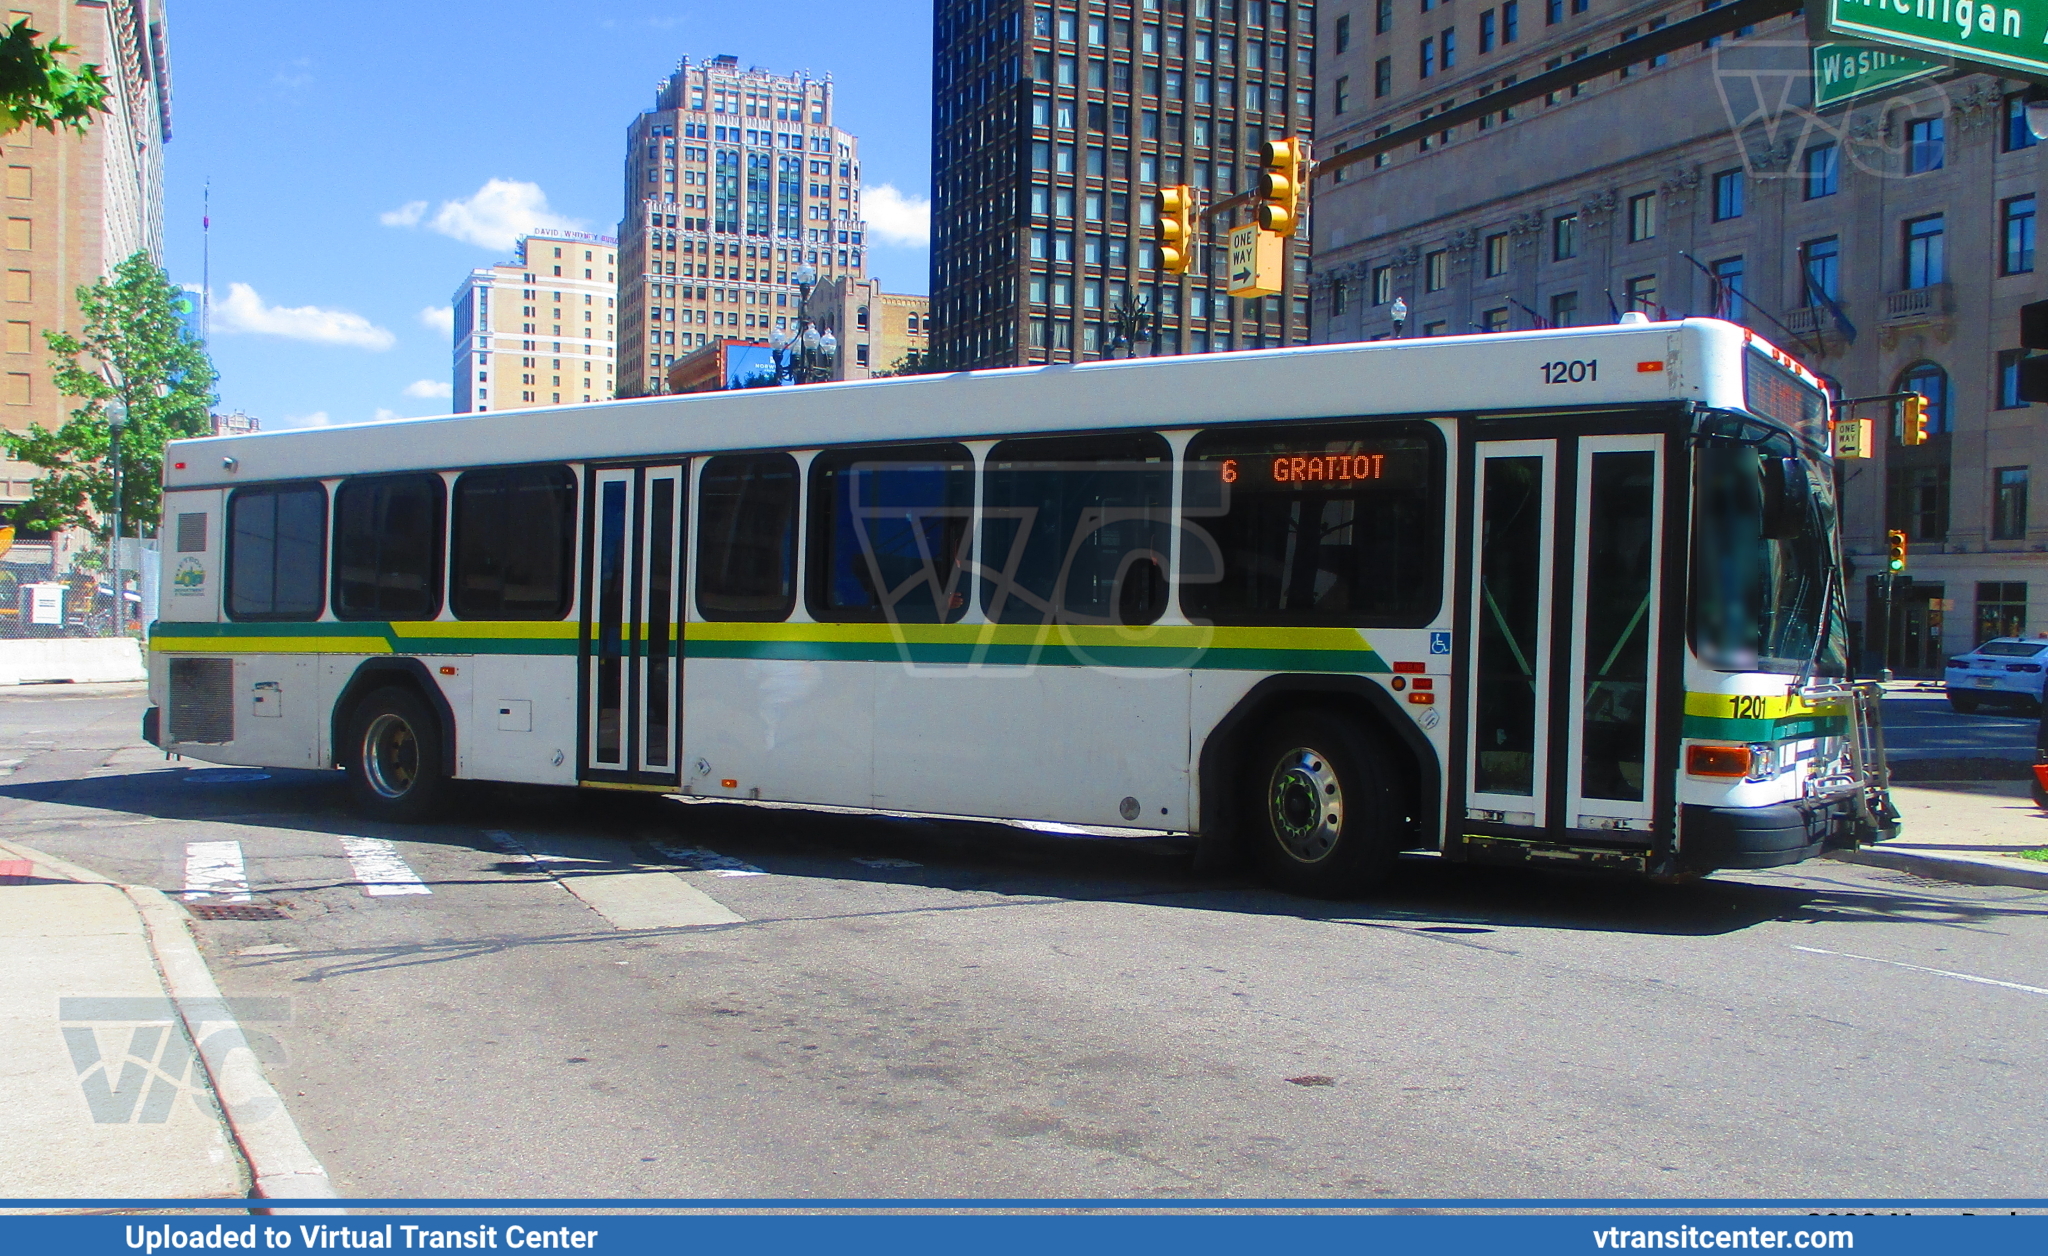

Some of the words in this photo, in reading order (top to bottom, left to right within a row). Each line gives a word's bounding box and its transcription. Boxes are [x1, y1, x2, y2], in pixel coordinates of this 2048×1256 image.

[1843, 0, 2021, 40] higan
[534, 227, 559, 236] DAVID
[1234, 231, 1252, 248] ONE
[1233, 248, 1253, 265] WAY
[1540, 359, 1597, 384] 1201
[1839, 424, 1856, 433] ONE
[1839, 434, 1856, 442] WAY
[1222, 459, 1237, 483] 6
[1273, 454, 1384, 482] GRATIOT
[1729, 695, 1766, 720] 1201
